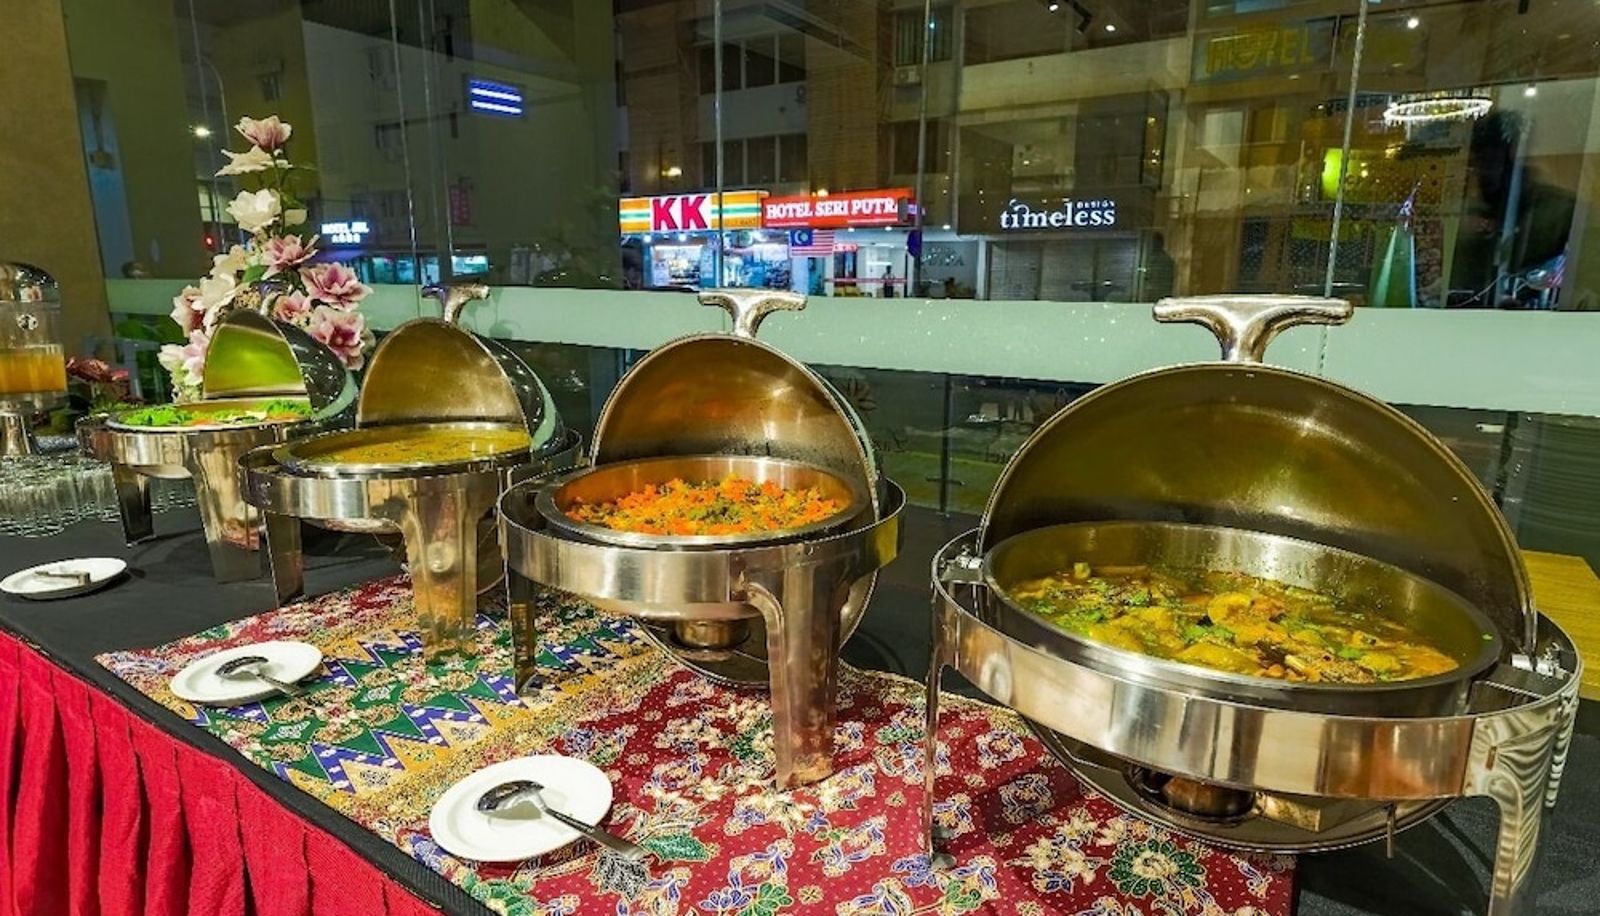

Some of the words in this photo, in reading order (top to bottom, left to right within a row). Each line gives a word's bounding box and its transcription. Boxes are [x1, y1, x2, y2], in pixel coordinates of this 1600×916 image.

[652, 195, 708, 231] KK
[765, 203, 813, 219] HOTEL
[815, 199, 849, 217] SERI
[851, 197, 898, 215] PUTR
[999, 199, 1116, 229] timeless
